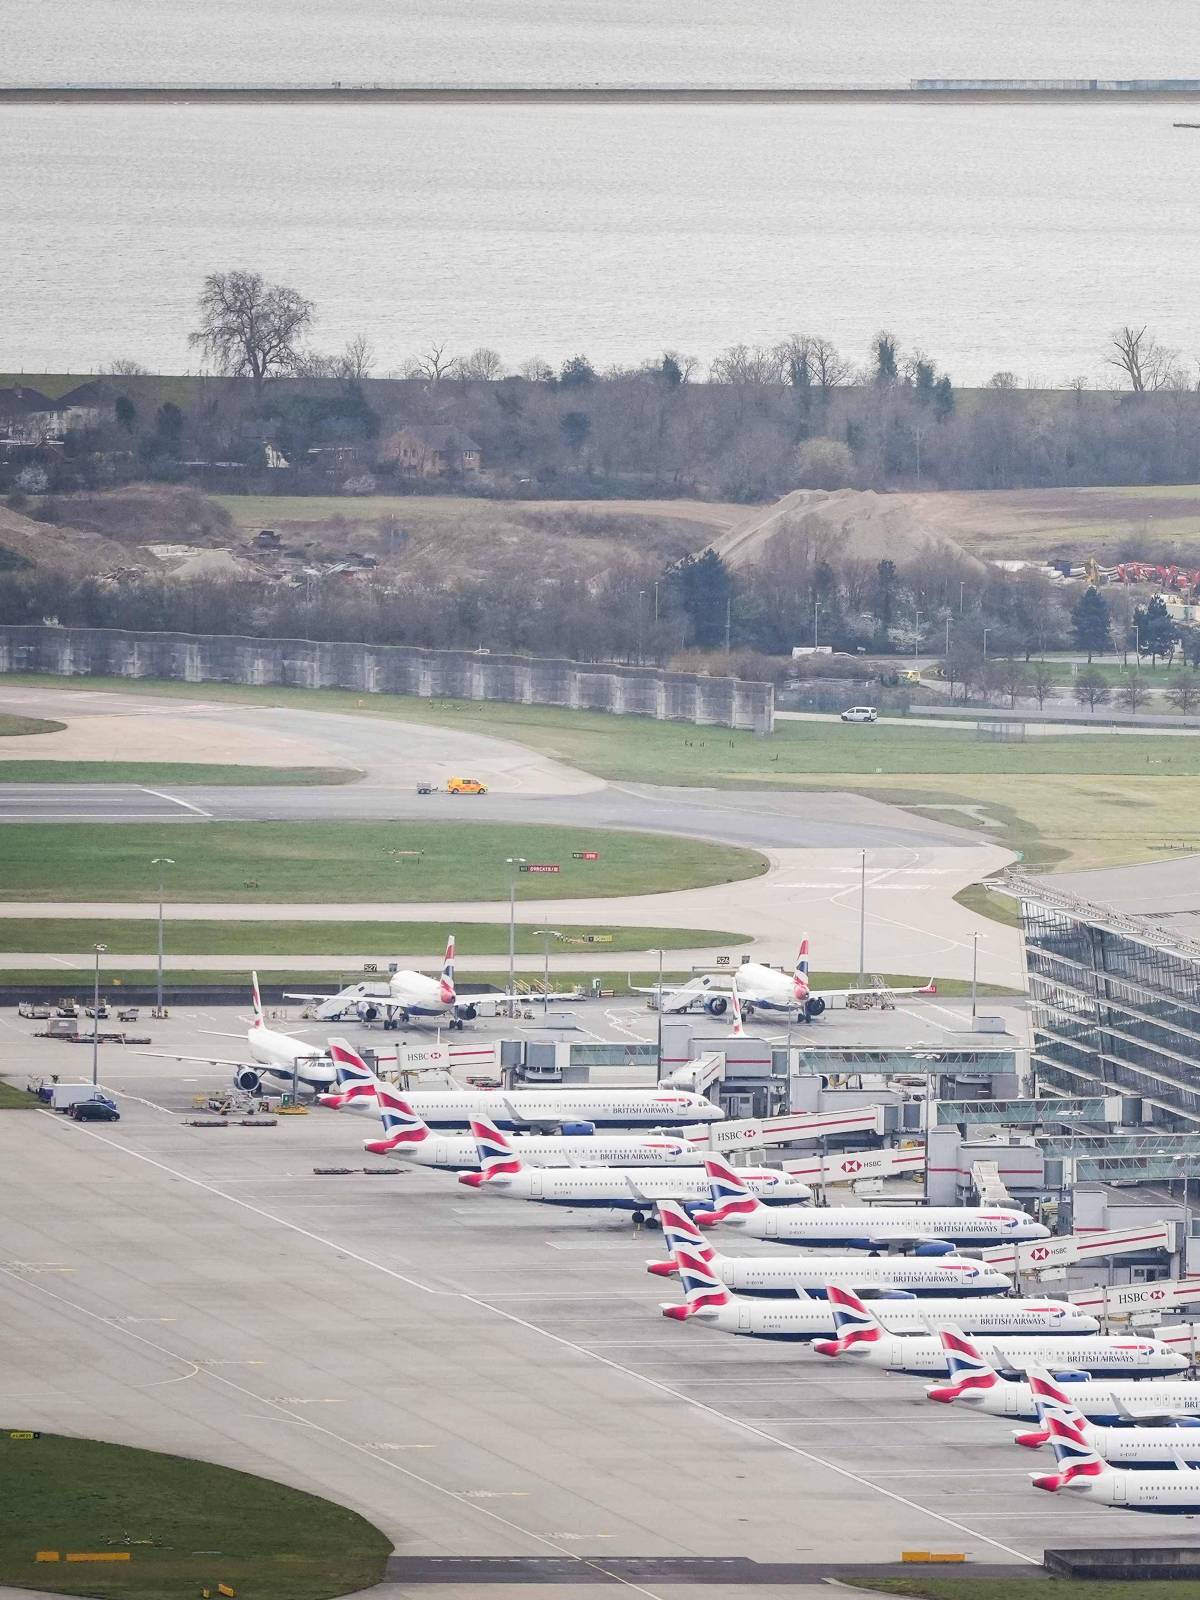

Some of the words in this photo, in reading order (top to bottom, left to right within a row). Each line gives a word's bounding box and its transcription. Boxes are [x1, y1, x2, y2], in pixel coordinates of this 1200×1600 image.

[407, 1052, 430, 1061] HSBC
[717, 1130, 743, 1141] HSBC
[863, 1160, 882, 1168] HSBC
[1050, 1247, 1067, 1255] HSBC
[1118, 1291, 1149, 1304] HSBC
[1067, 1355, 1099, 1363] BRITISH
[1100, 1355, 1135, 1363] AIRWAYS
